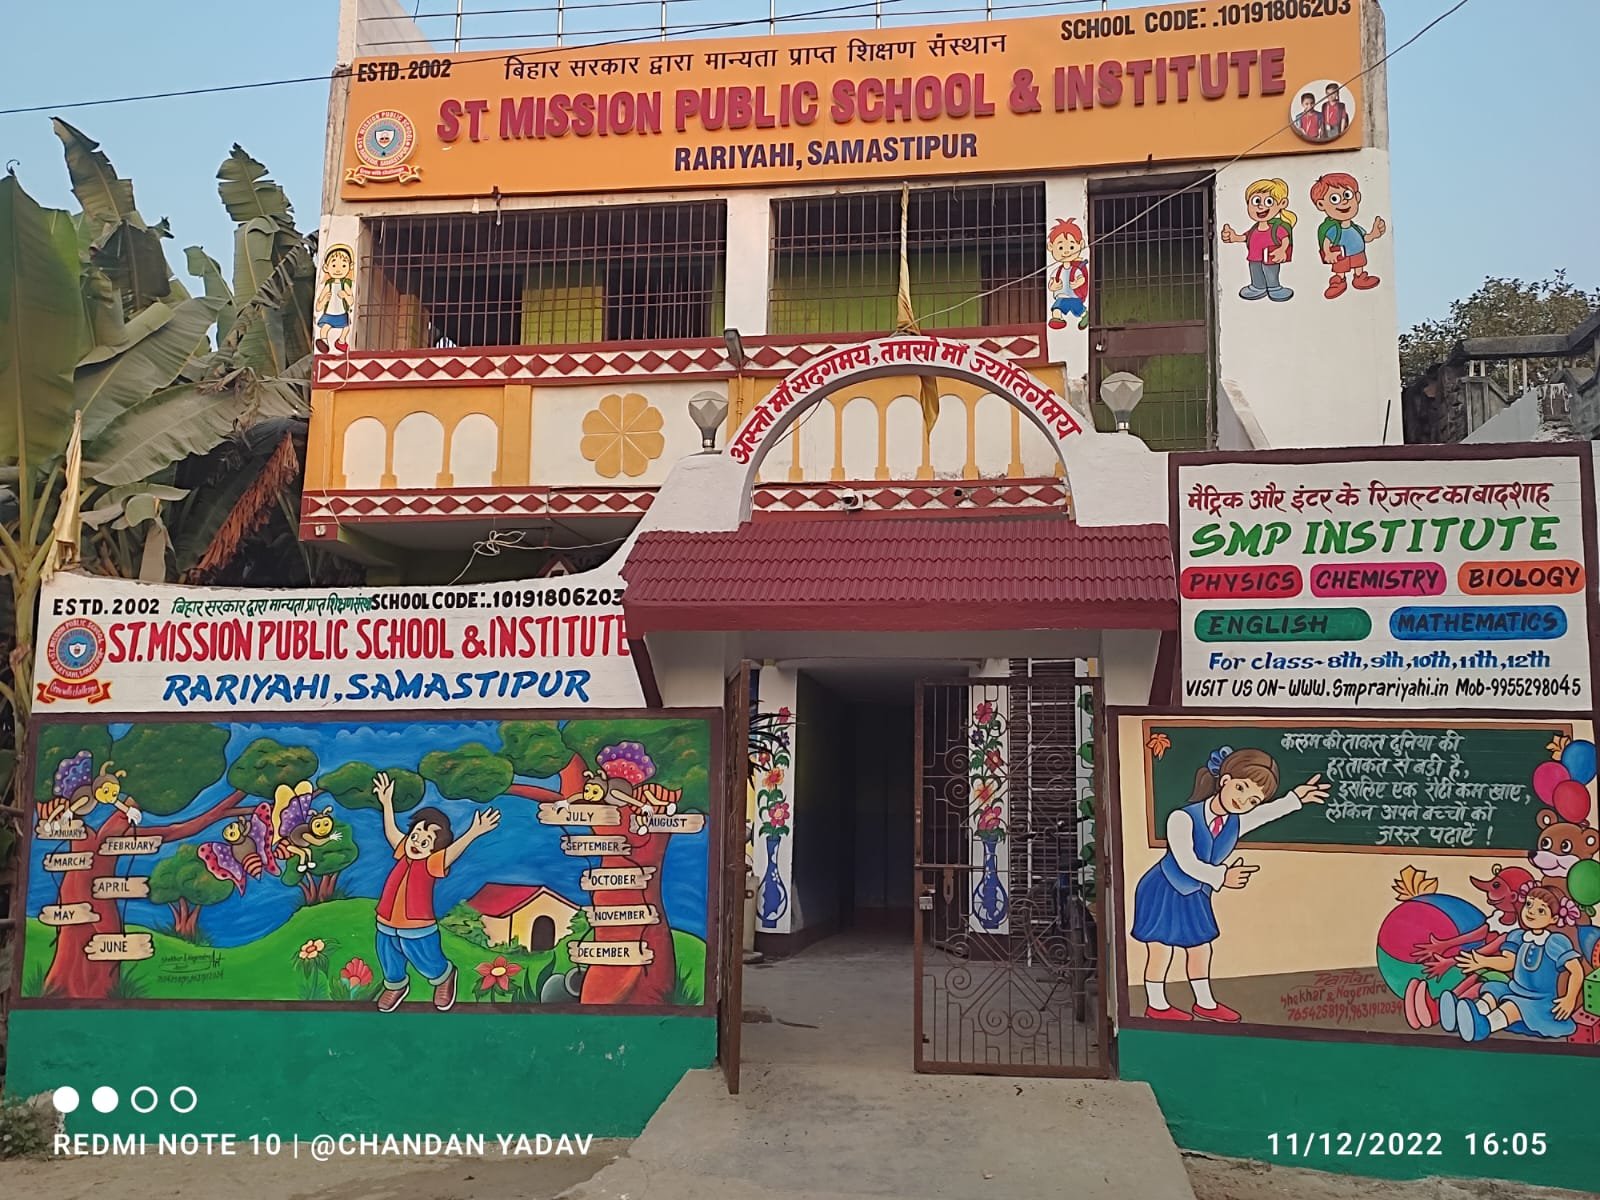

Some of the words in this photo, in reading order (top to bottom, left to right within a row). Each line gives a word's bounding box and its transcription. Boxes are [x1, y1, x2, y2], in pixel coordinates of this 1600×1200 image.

[1061, 15, 1135, 40] SCHOOL
[504, 57, 561, 80] बिहार
[569, 57, 641, 77] सरकार
[649, 54, 694, 75] द्वारा
[704, 49, 779, 70] मान्यता
[789, 46, 838, 65] प्राप्त
[847, 38, 917, 62] शिक्षण
[928, 33, 1007, 57] संस्थान
[357, 59, 451, 82] ESTD.2002
[500, 91, 662, 140] MISSION
[675, 81, 818, 132] PUBLIC
[830, 73, 995, 124] SCHOOL
[1009, 68, 1041, 114] &
[1055, 47, 1286, 113] INSTITUTE
[675, 142, 802, 171] RARIYAHI,
[807, 133, 977, 166] SAMASTIPUR
[1187, 483, 1244, 518] मैट्रिक
[1249, 482, 1287, 512] और
[1291, 485, 1333, 513] इंटर
[1335, 482, 1361, 506] के
[1368, 480, 1443, 513] रिजल्ट
[1189, 521, 1292, 558] SMP
[1302, 516, 1560, 557] INSTITUTE
[1189, 566, 1296, 592] PHYSICS
[1315, 567, 1440, 595] CHEMISTRY
[1468, 566, 1581, 588] BIOLOGY
[53, 598, 160, 616] ESTD.2002
[171, 597, 203, 618] बिहार
[204, 599, 247, 617] सरकार
[247, 599, 269, 617] द्वारा
[269, 599, 305, 617] मान्यता
[371, 593, 429, 610] SCHOOL
[1207, 614, 1328, 636] ENGLISH
[1398, 611, 1558, 633] MATHEMATICS
[258, 619, 348, 661] PUBLIC
[356, 617, 454, 660] SCHOOL
[1209, 652, 1245, 671] For
[1186, 679, 1228, 697] VISIT
[1231, 680, 1253, 697] US
[1281, 733, 1324, 754] कलम
[1322, 729, 1345, 750] की
[1342, 734, 1389, 757] ताकत
[1390, 729, 1438, 757] दुनिया
[1438, 729, 1466, 752] की
[1327, 757, 1348, 782] हर
[1345, 757, 1393, 778] ताकत
[1393, 750, 1415, 778] से
[1338, 774, 1389, 801] इसलिए
[1391, 781, 1418, 799] एक
[1455, 782, 1489, 798] कम
[566, 812, 594, 822] JULY
[1326, 798, 1379, 823] लेकिन
[1381, 799, 1422, 820] अपने
[1422, 801, 1470, 821] बच्चों
[1471, 801, 1498, 821] को
[49, 828, 82, 838] JANUARY
[649, 818, 688, 828] AUGUST
[108, 841, 154, 851] FEBRUARY
[566, 841, 619, 851] SEPTEMBER
[53, 856, 86, 866] MARCH
[97, 881, 130, 892] APRIL
[591, 875, 636, 886] OCTOBER
[53, 910, 75, 921] MAY
[595, 910, 645, 921] NOVEMBER
[100, 941, 128, 953] JUNE
[577, 947, 630, 958] DECEMBER
